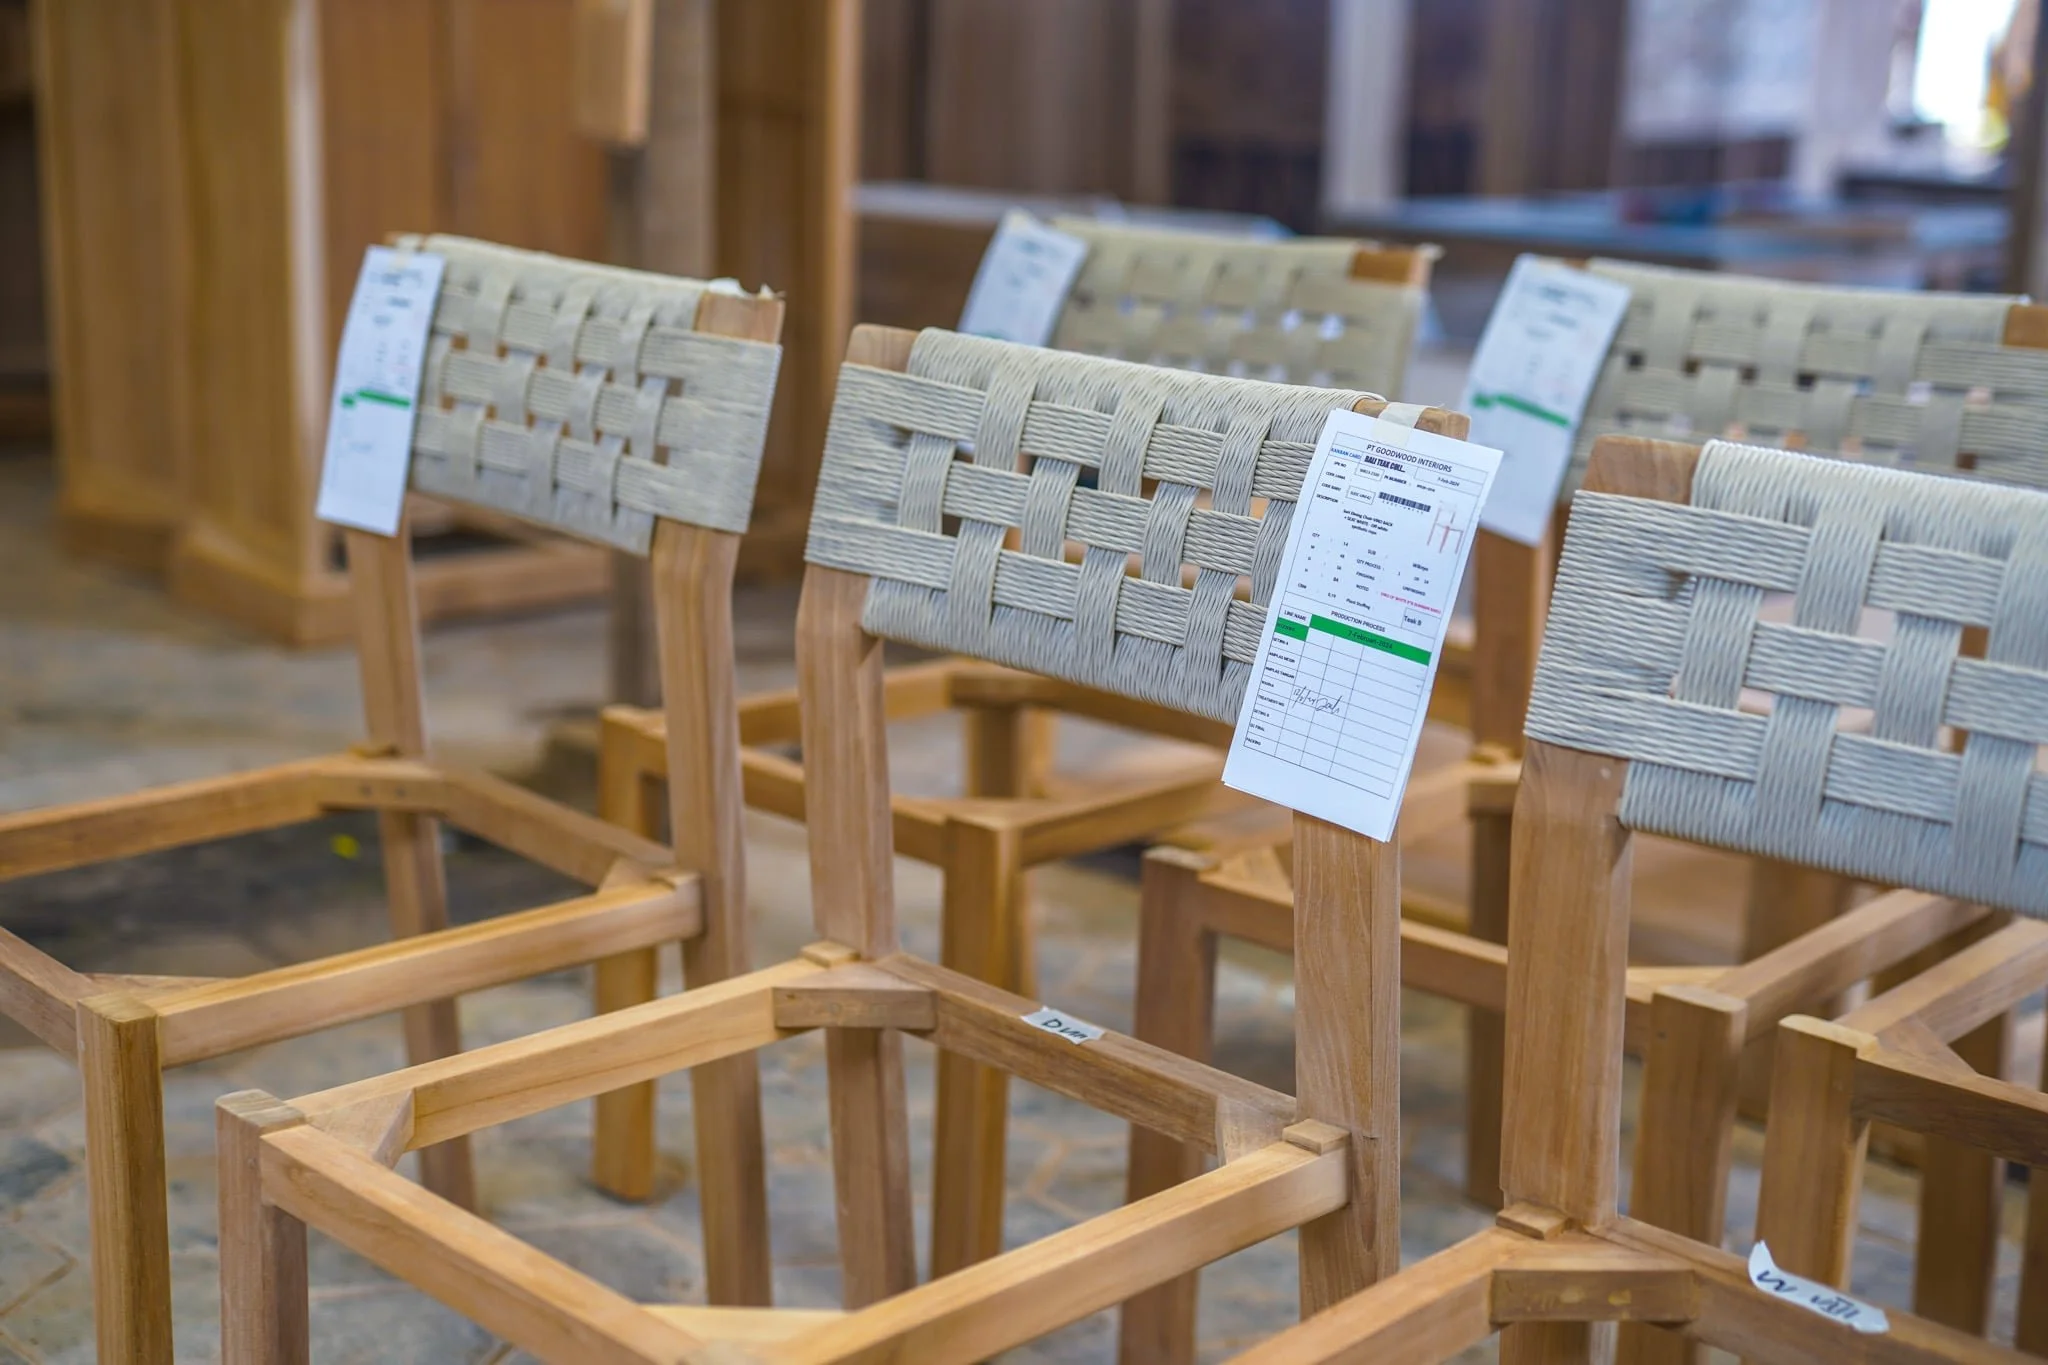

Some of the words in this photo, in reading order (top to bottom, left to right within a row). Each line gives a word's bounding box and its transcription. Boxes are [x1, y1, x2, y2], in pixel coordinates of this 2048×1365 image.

[1364, 455, 1376, 464] BALI
[1376, 458, 1389, 468] TEAK
[1375, 446, 1417, 463] GOODWOOD
[1417, 457, 1452, 472] INTERIORS
[1316, 493, 1338, 502] DESCRIPTION
[1364, 561, 1381, 569] PROCESS
[1330, 610, 1362, 624] PRODUCTION
[1362, 620, 1385, 632] PROCESS
[1403, 615, 1416, 624] Teak
